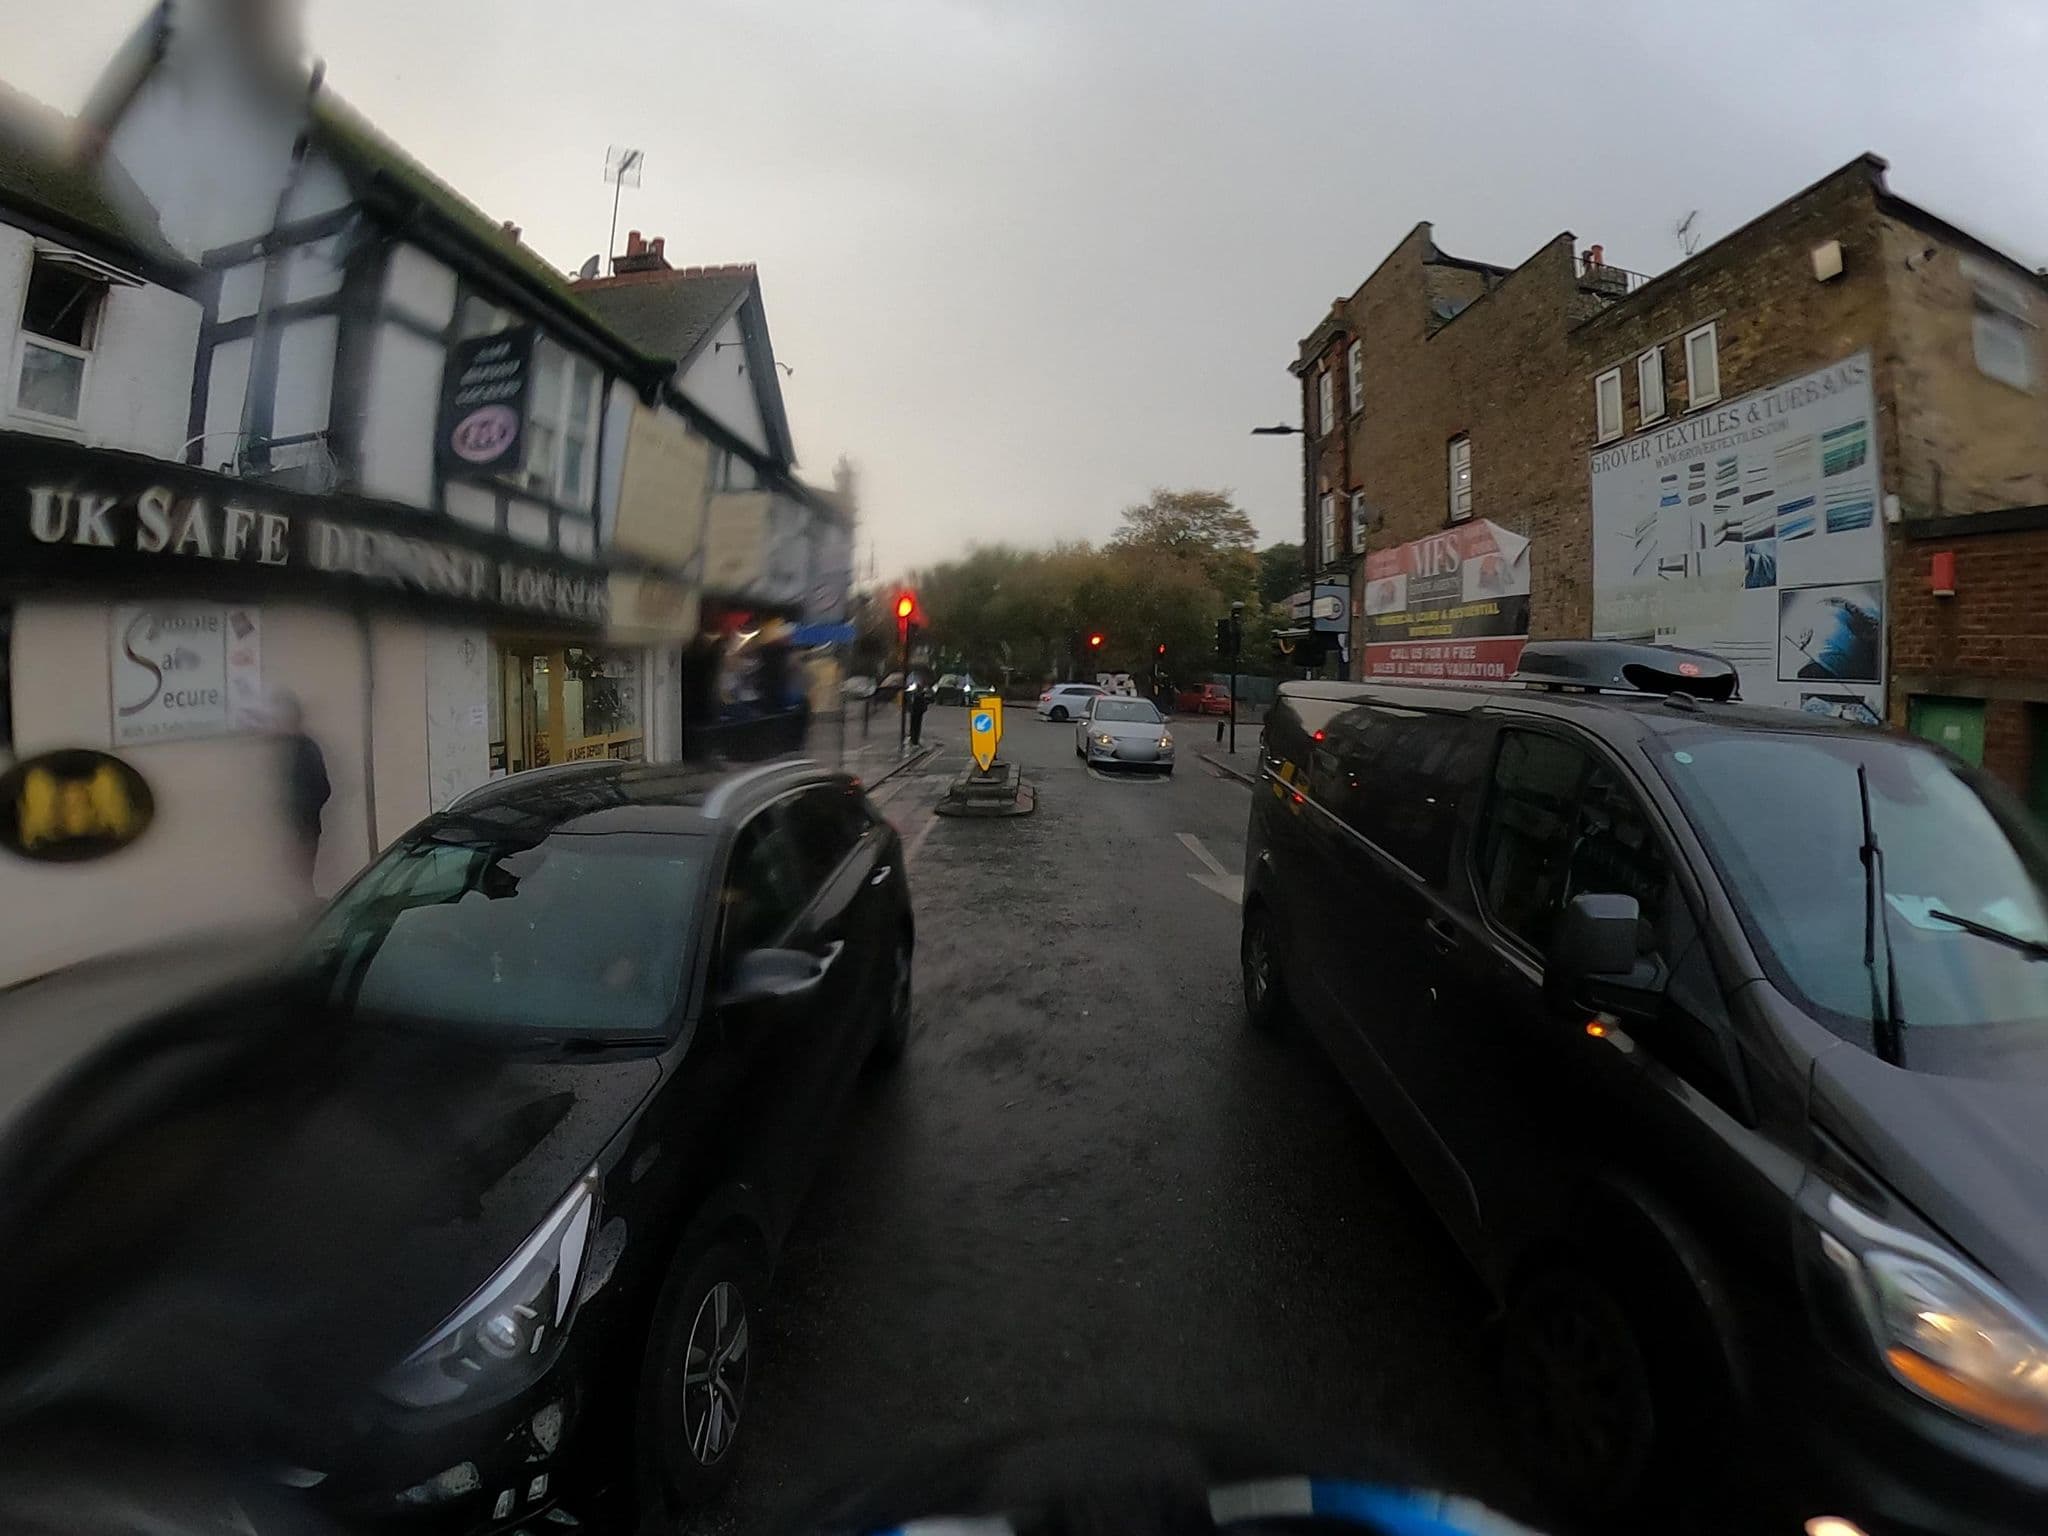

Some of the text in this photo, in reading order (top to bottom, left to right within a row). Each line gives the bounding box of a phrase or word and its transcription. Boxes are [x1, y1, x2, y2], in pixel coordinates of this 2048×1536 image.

[1591, 441, 1651, 474] GROVER
[1656, 408, 1741, 450] TEXTILES
[1747, 402, 1760, 424] &
[28, 487, 116, 547] UK
[136, 484, 290, 566] SAFE
[1390, 647, 1409, 660] CALL
[1411, 647, 1422, 659] US
[1425, 646, 1441, 659] FOR
[1453, 645, 1477, 660] FREE
[1446, 662, 1505, 678] VALUATION
